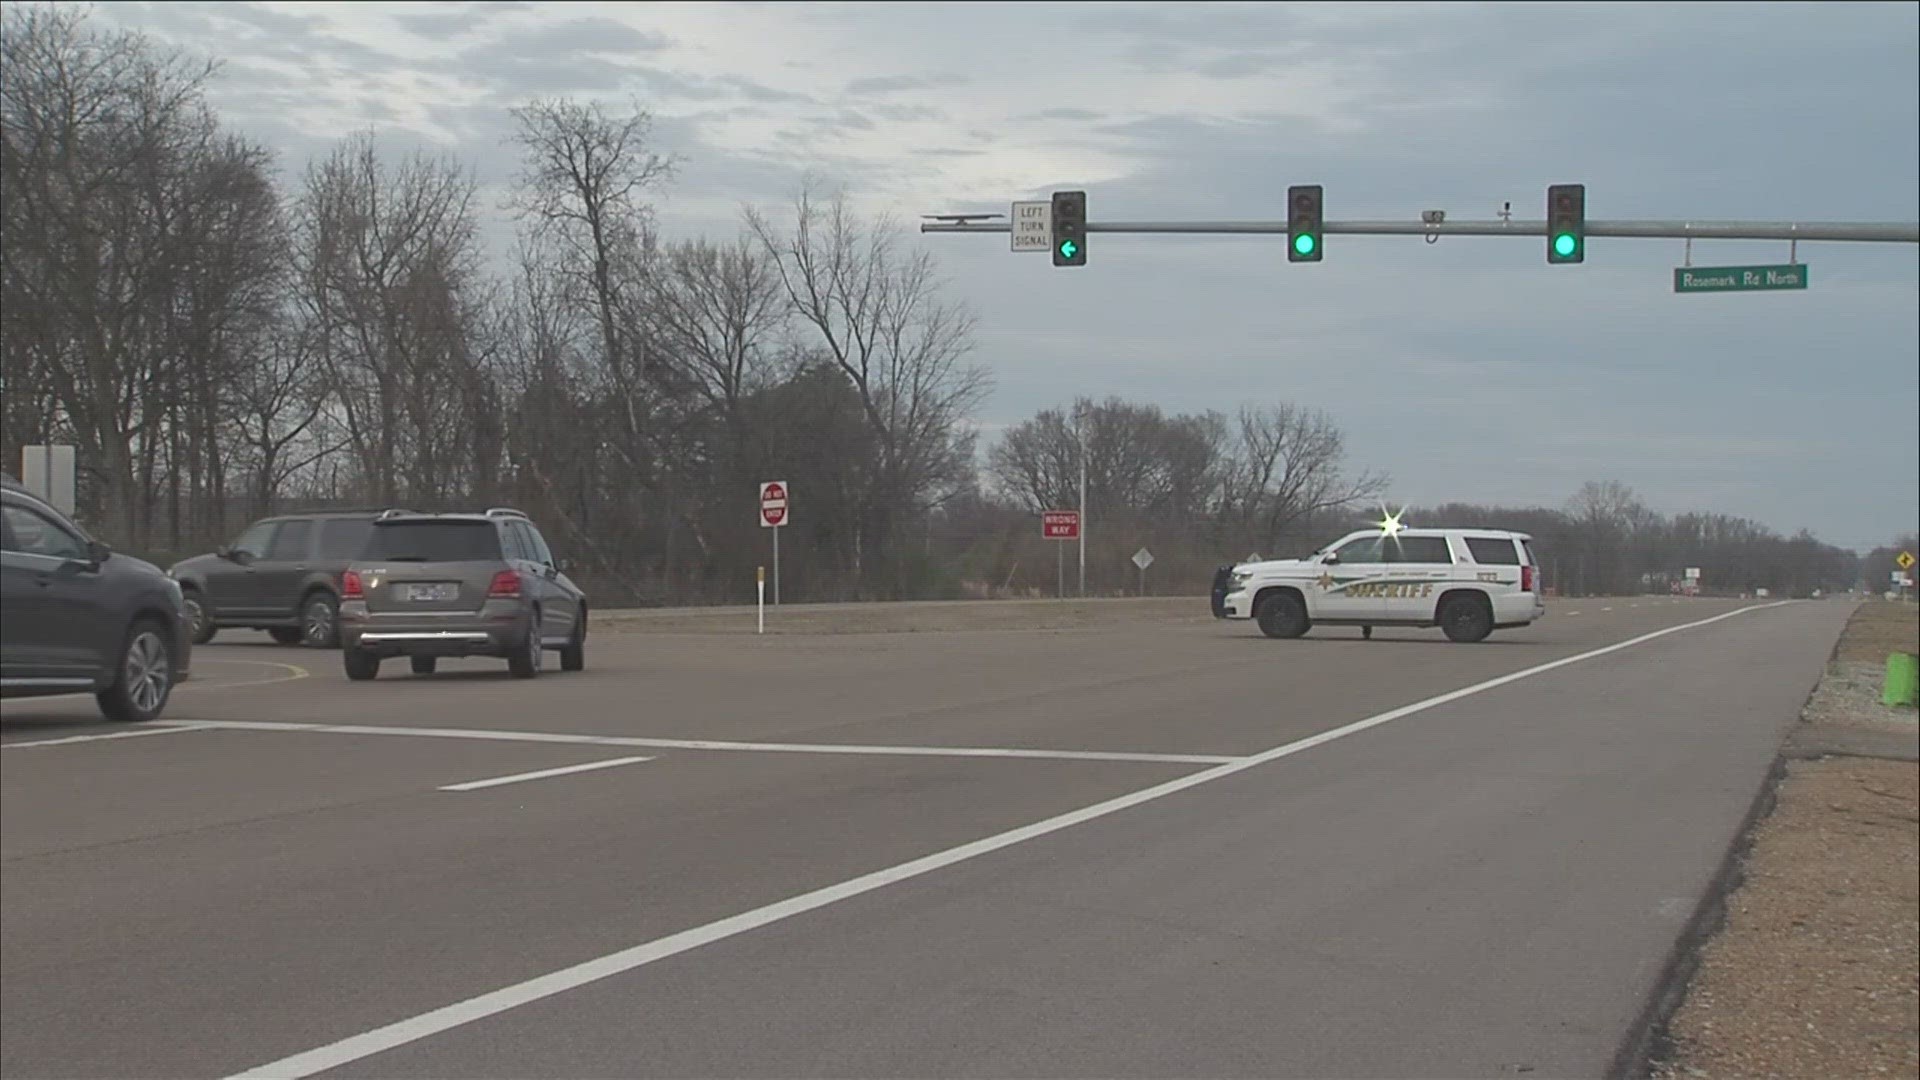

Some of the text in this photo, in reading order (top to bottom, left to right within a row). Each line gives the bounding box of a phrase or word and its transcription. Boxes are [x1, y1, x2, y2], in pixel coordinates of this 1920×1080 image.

[1021, 207, 1042, 218] LEFT
[1021, 221, 1044, 231] TURN
[1015, 235, 1047, 246] SIGNAL
[1683, 270, 1799, 287] Rosemark Rd North
[1045, 514, 1077, 525] WRONG
[1052, 526, 1070, 535] WAY
[1344, 584, 1434, 598] SHERIFF
